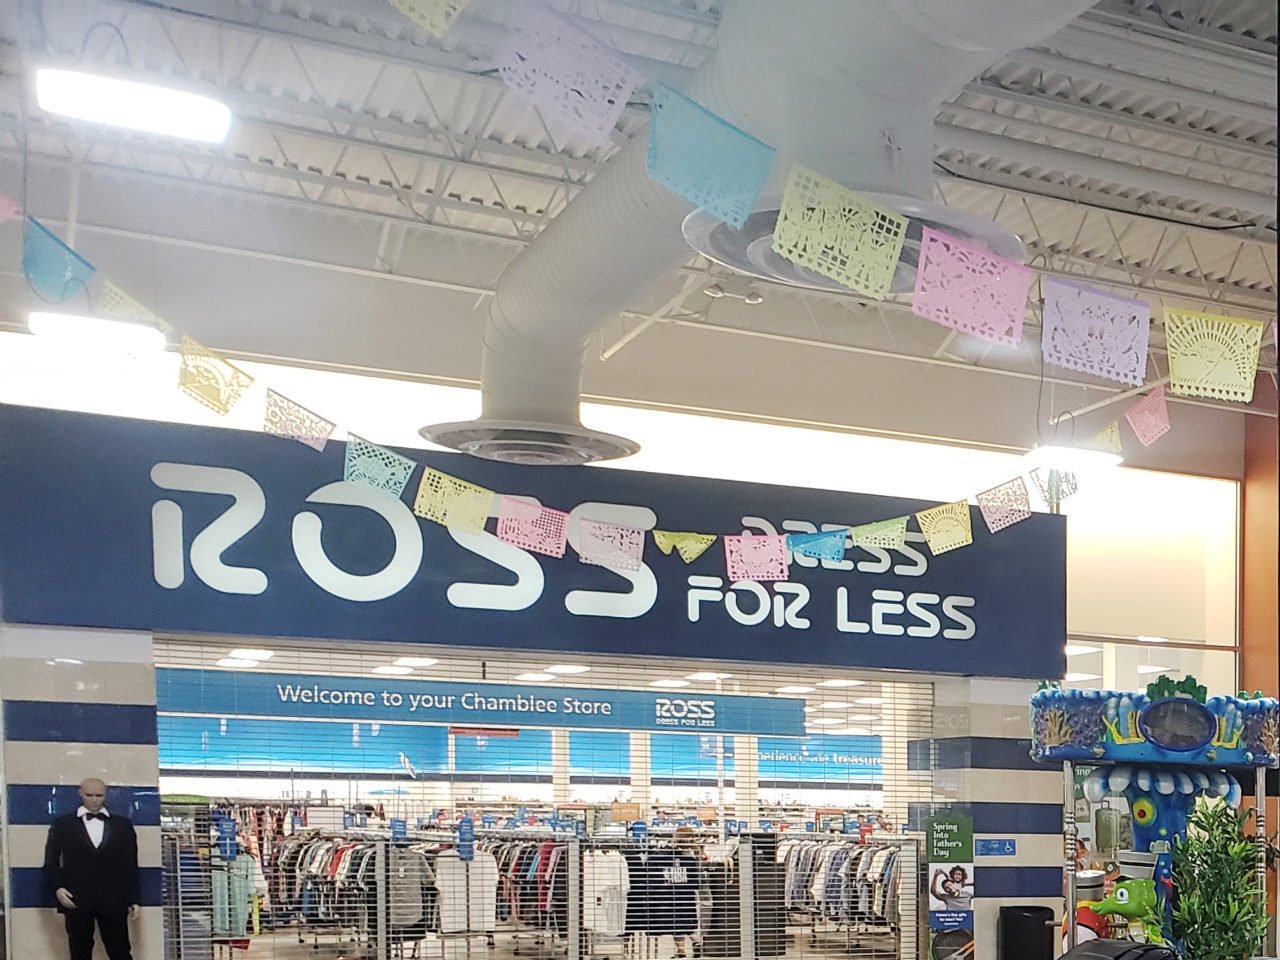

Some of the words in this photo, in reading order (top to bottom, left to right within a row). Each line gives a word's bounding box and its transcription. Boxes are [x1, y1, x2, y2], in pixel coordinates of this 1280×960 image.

[150, 462, 658, 618] ROSS
[687, 575, 811, 629] FOR
[836, 586, 976, 640] LESS
[277, 684, 376, 706] Welcome
[381, 689, 403, 706] to
[409, 692, 454, 712] your
[461, 692, 557, 713] Chamblee
[563, 697, 612, 715] Store
[655, 698, 715, 719] ROSS
[933, 822, 958, 832] Spring
[933, 831, 949, 839] Into
[933, 840, 962, 848] Father's
[933, 848, 949, 858] Day
